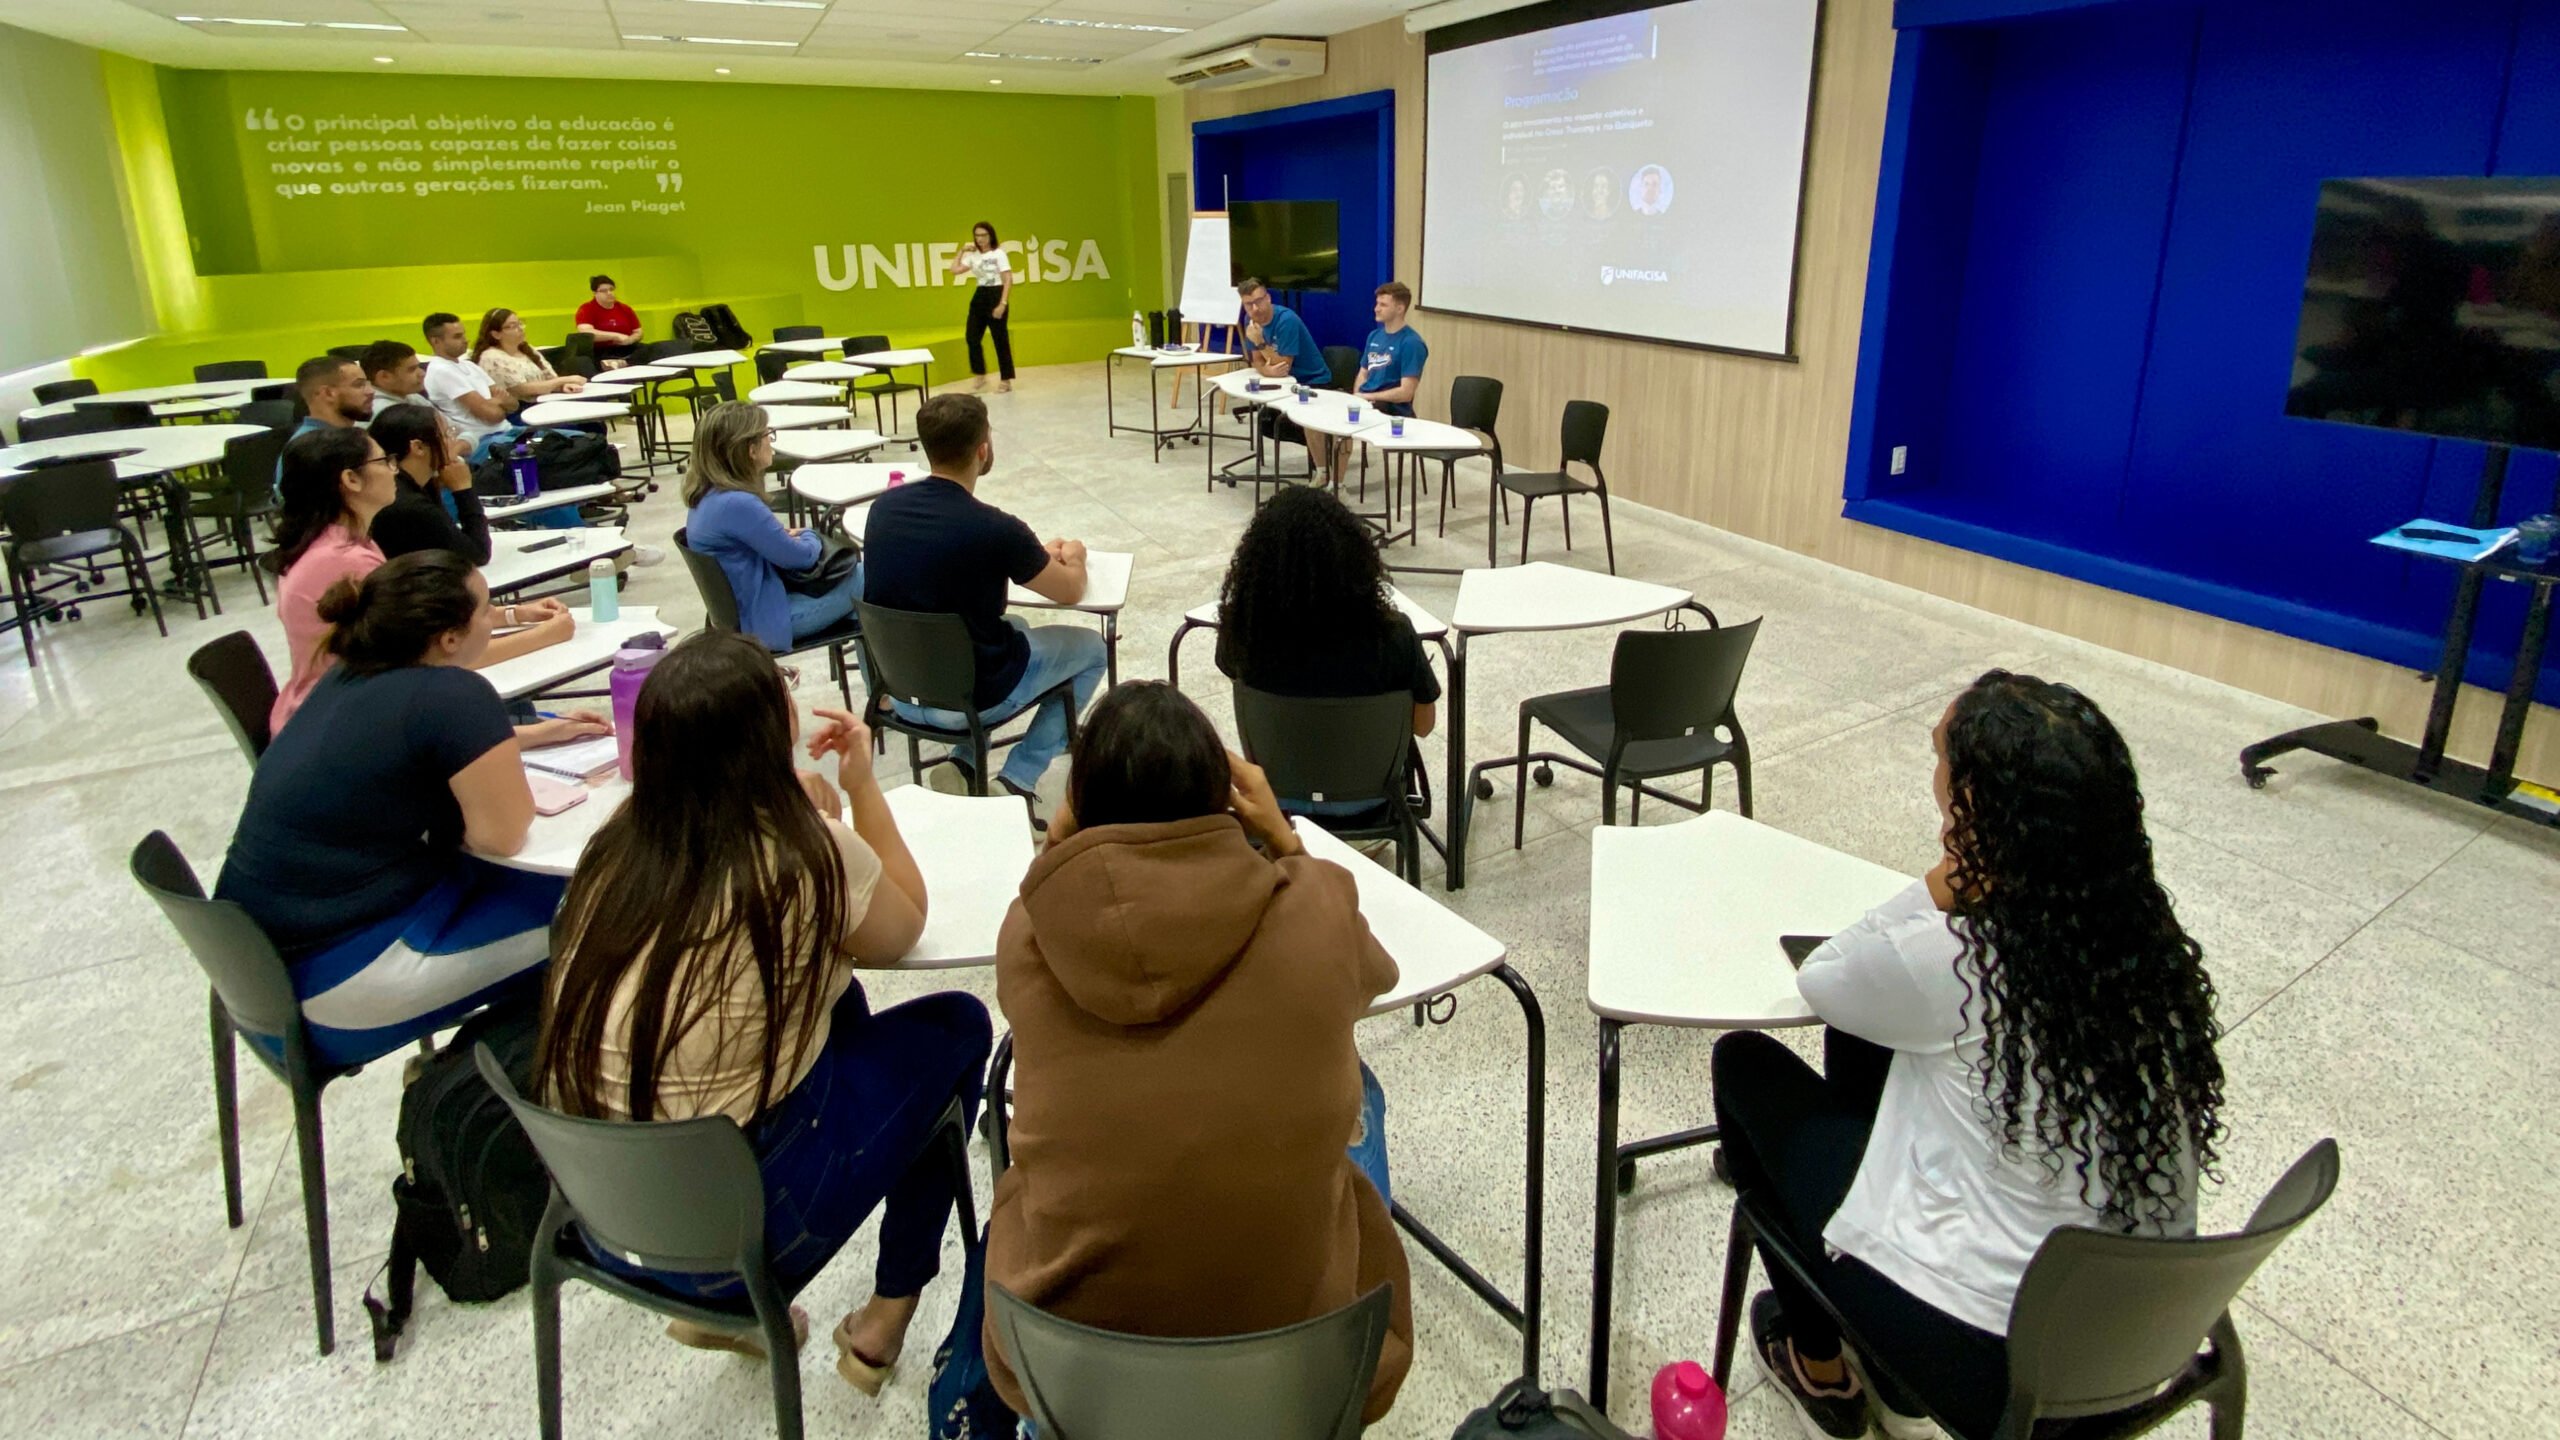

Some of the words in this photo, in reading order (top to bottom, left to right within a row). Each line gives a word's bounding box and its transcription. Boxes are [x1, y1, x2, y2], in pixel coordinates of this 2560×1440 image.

[314, 113, 419, 134] principal
[426, 113, 518, 134] objetivo
[525, 115, 554, 131] da
[662, 116, 675, 132] é
[266, 136, 323, 153] criar
[328, 139, 424, 157] pessoas
[430, 139, 520, 156] capazes
[526, 135, 553, 151] de
[557, 135, 612, 151] fazer
[618, 137, 678, 151] coisas
[270, 161, 344, 175] novas
[352, 161, 368, 174] e
[377, 157, 423, 172] não
[432, 156, 582, 175] simplesmente
[590, 155, 657, 174] repetir
[667, 159, 680, 170] o
[275, 182, 323, 200] que
[329, 179, 407, 196] outras
[413, 177, 516, 198] gerações
[521, 174, 609, 192] fizeram.
[584, 199, 626, 214] Jean
[631, 198, 687, 216] Piaget
